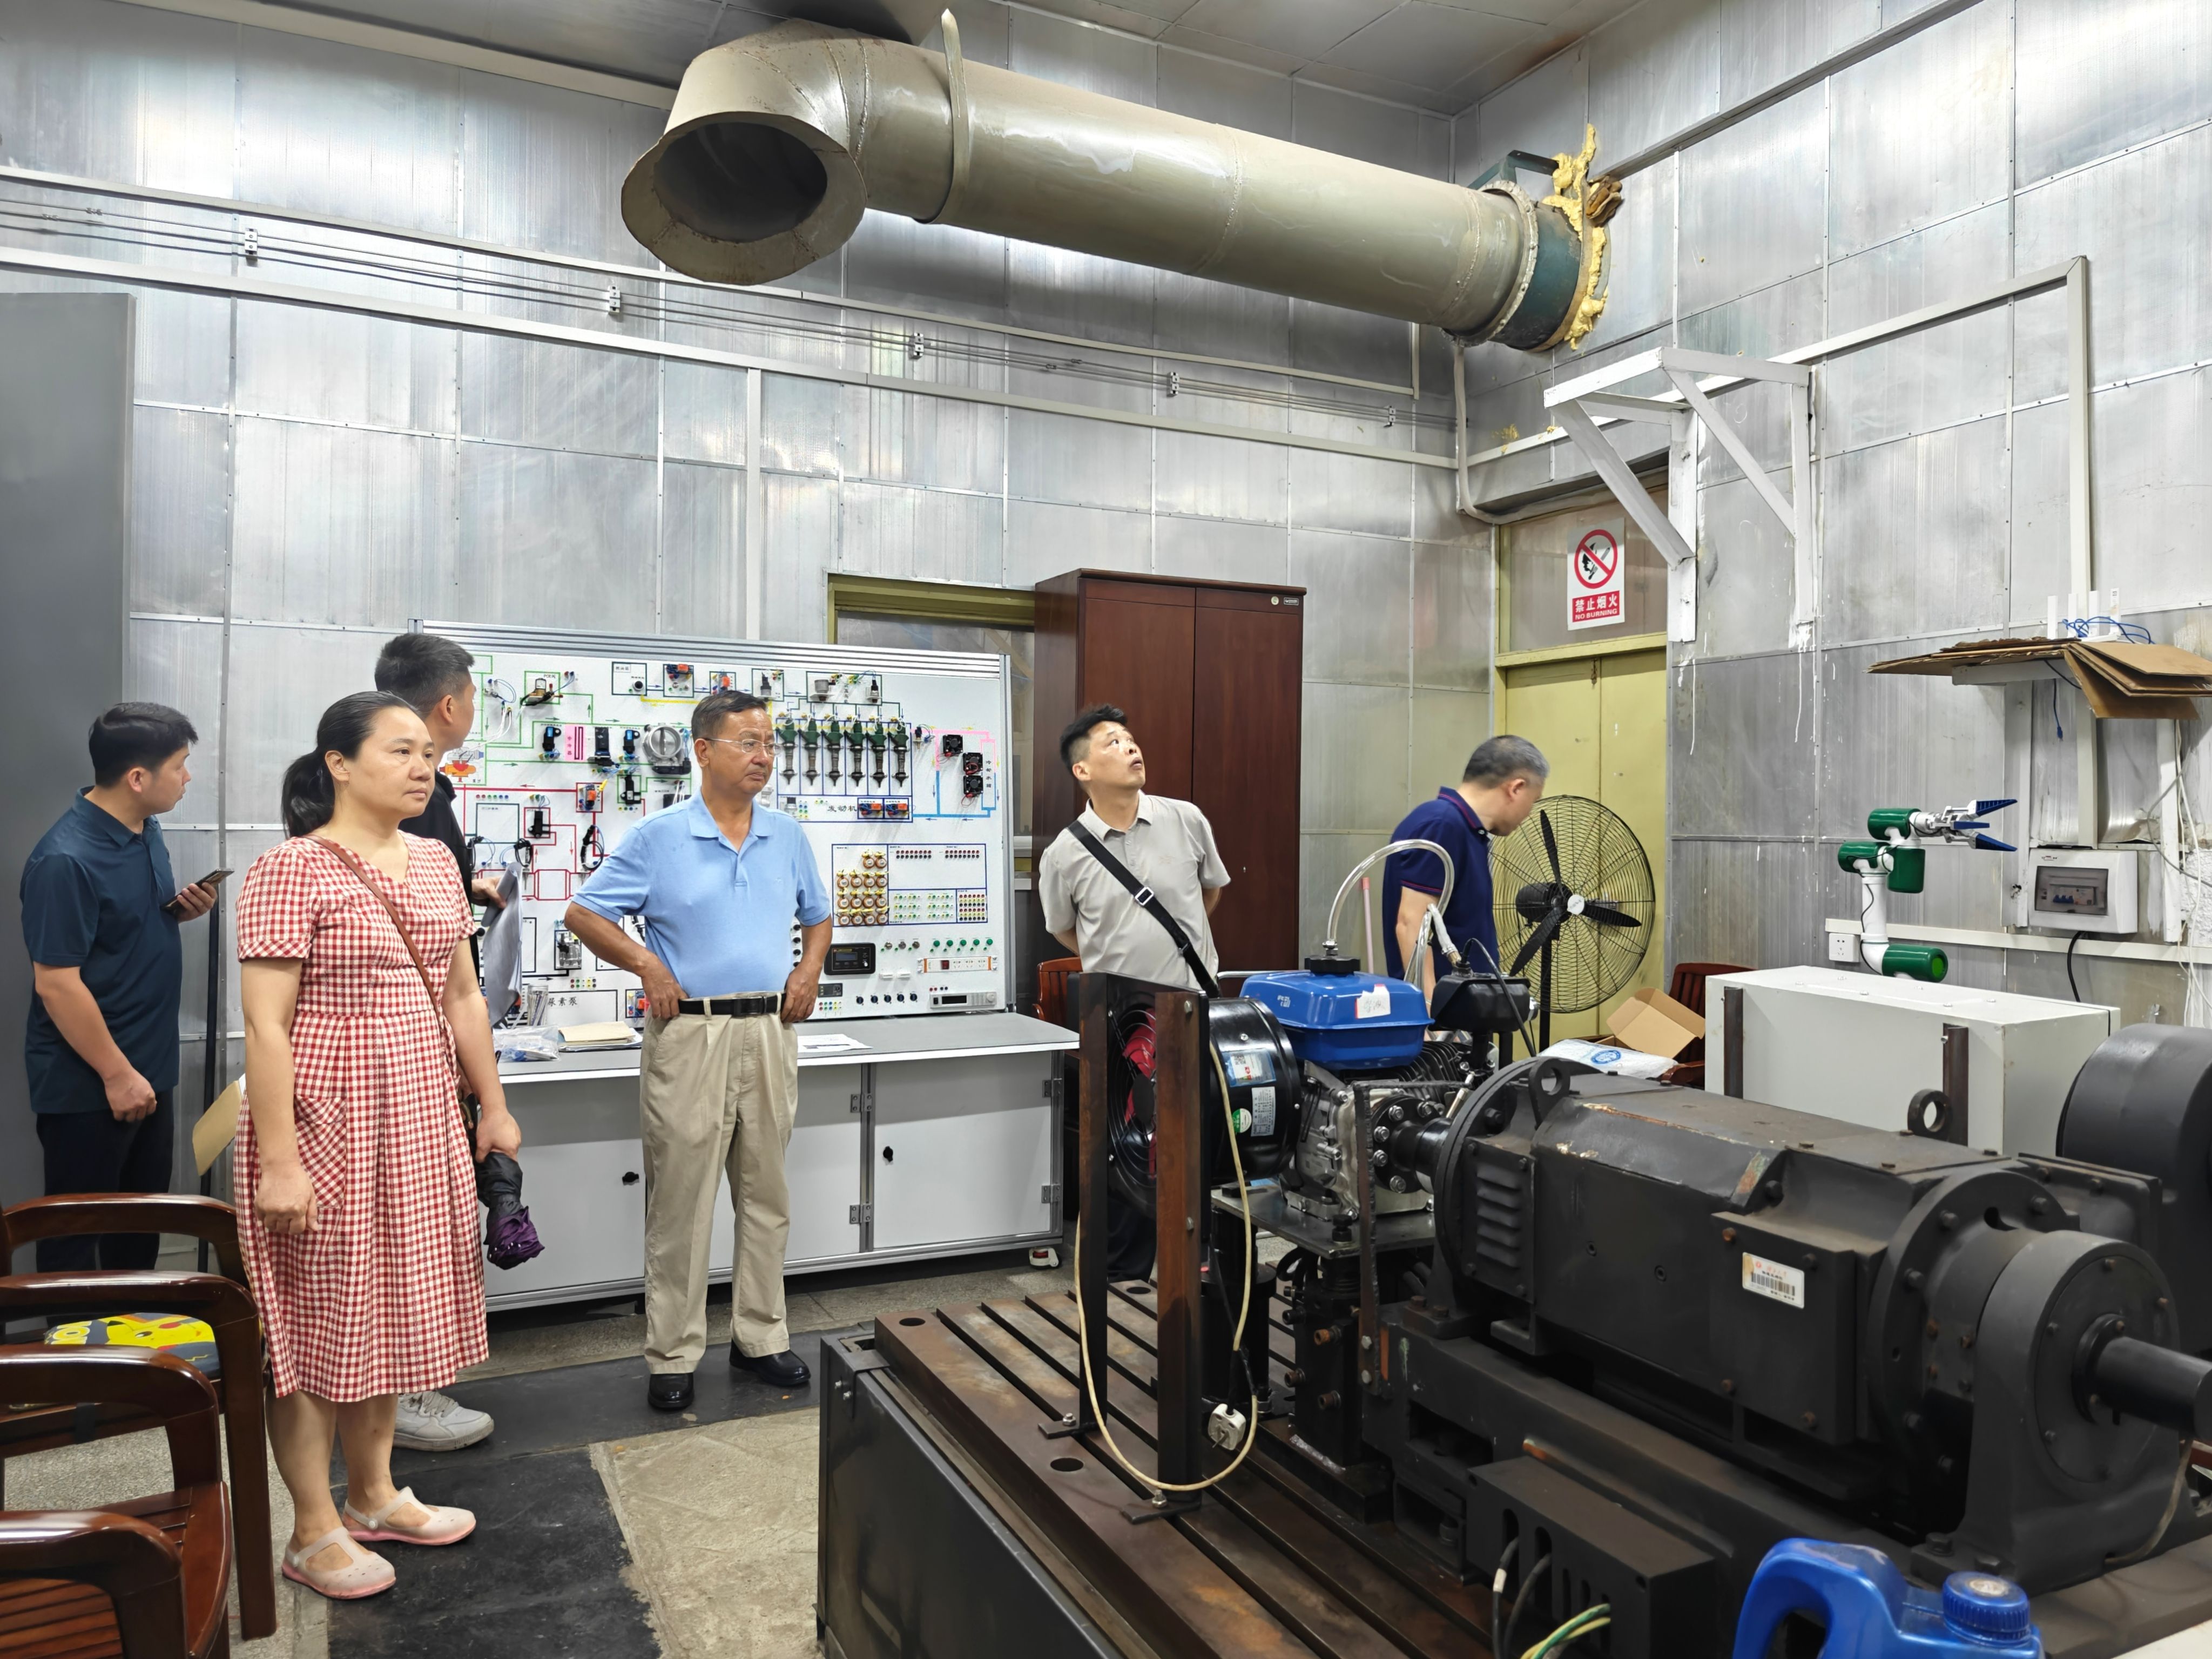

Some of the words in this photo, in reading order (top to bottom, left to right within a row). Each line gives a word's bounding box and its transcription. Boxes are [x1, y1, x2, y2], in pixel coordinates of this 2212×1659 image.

[1575, 594, 1617, 613] 禁止烟火
[1586, 609, 1617, 618] BURNING
[548, 996, 578, 1007] 尿素泵
